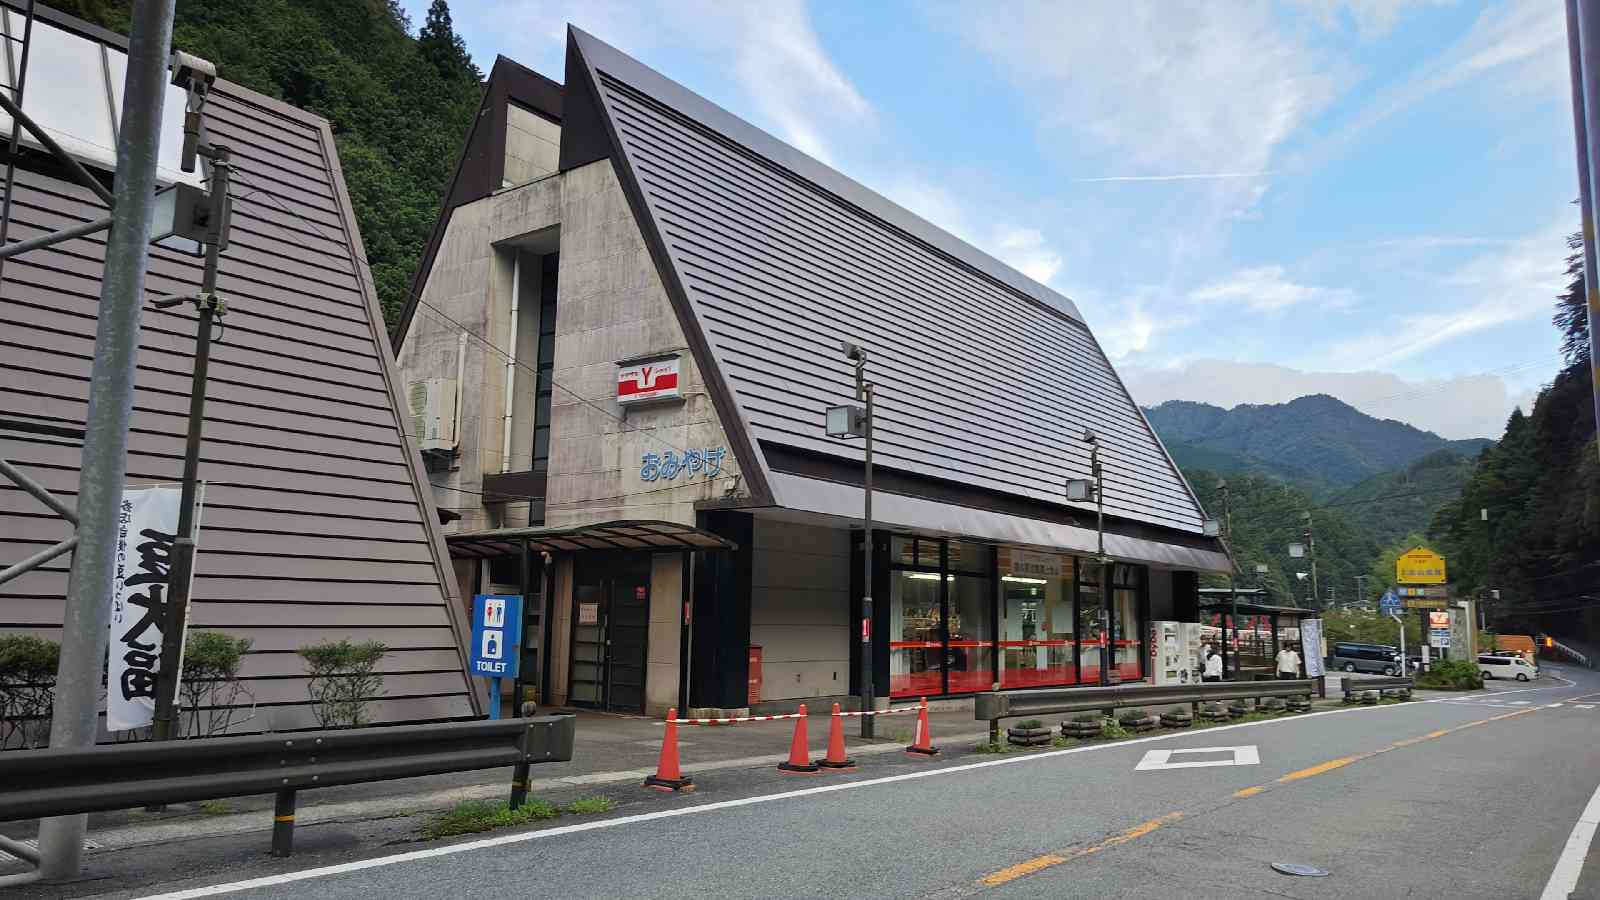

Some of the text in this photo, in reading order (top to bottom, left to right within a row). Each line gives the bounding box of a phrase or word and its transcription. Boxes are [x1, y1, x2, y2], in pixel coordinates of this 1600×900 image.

[640, 447, 726, 482] おみやげ
[475, 660, 508, 673] TOILET
